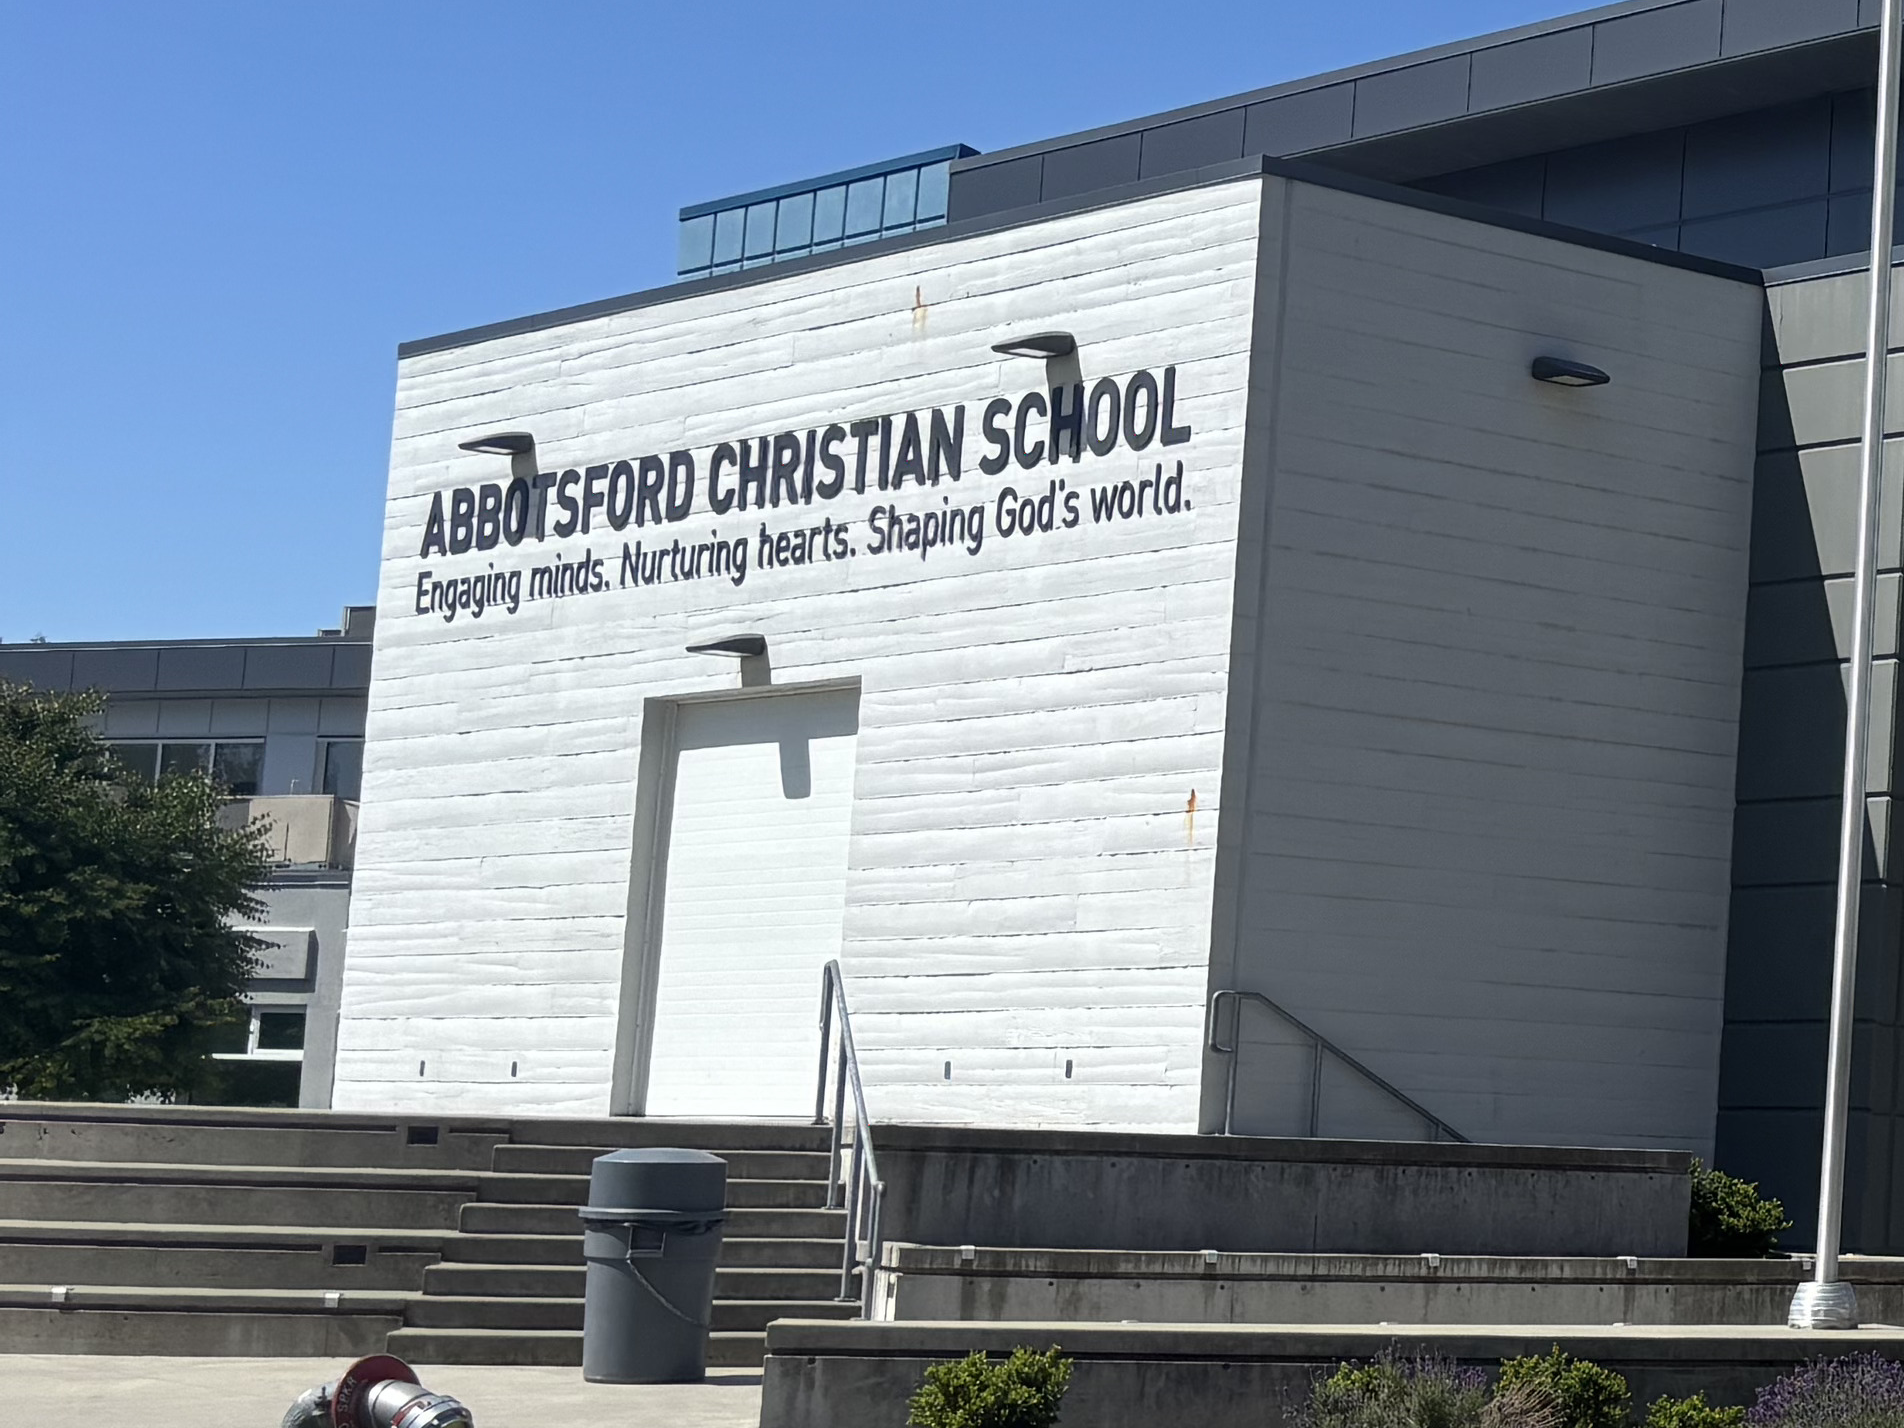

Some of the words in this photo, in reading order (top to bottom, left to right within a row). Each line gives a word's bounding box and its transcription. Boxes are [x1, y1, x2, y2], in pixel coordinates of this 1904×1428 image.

[416, 563, 521, 623] Engaging
[529, 548, 610, 599] minds.
[620, 529, 748, 586] Nurturing
[757, 517, 856, 570] hearts.
[867, 496, 985, 561] Shaping
[995, 478, 1079, 539] God's
[1091, 459, 1191, 523] world.
[420, 450, 694, 559] ABBOTSFORD
[709, 405, 965, 515] CHRISTIAN
[979, 365, 1191, 475] SCHOOL
